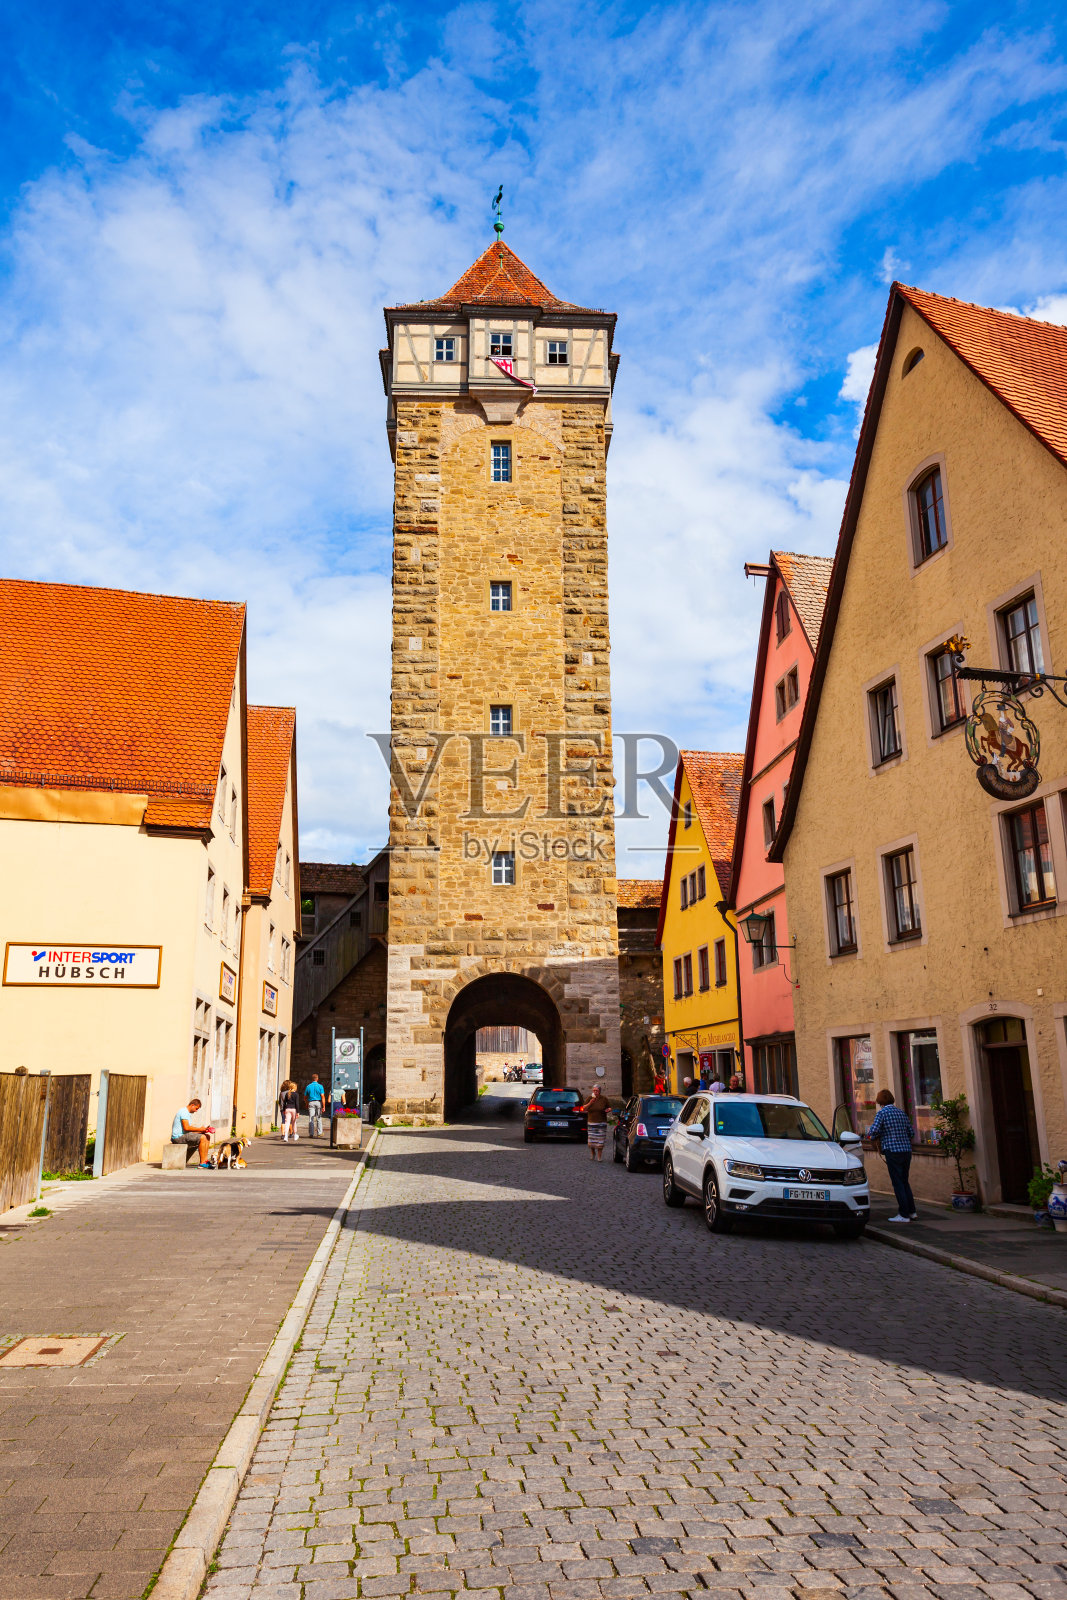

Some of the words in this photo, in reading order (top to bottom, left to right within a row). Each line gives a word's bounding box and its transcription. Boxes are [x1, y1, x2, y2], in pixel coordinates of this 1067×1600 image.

[48, 950, 136, 964] INTERSPORT
[38, 964, 125, 979] HÜBSCH
[989, 1003, 998, 1011] 32
